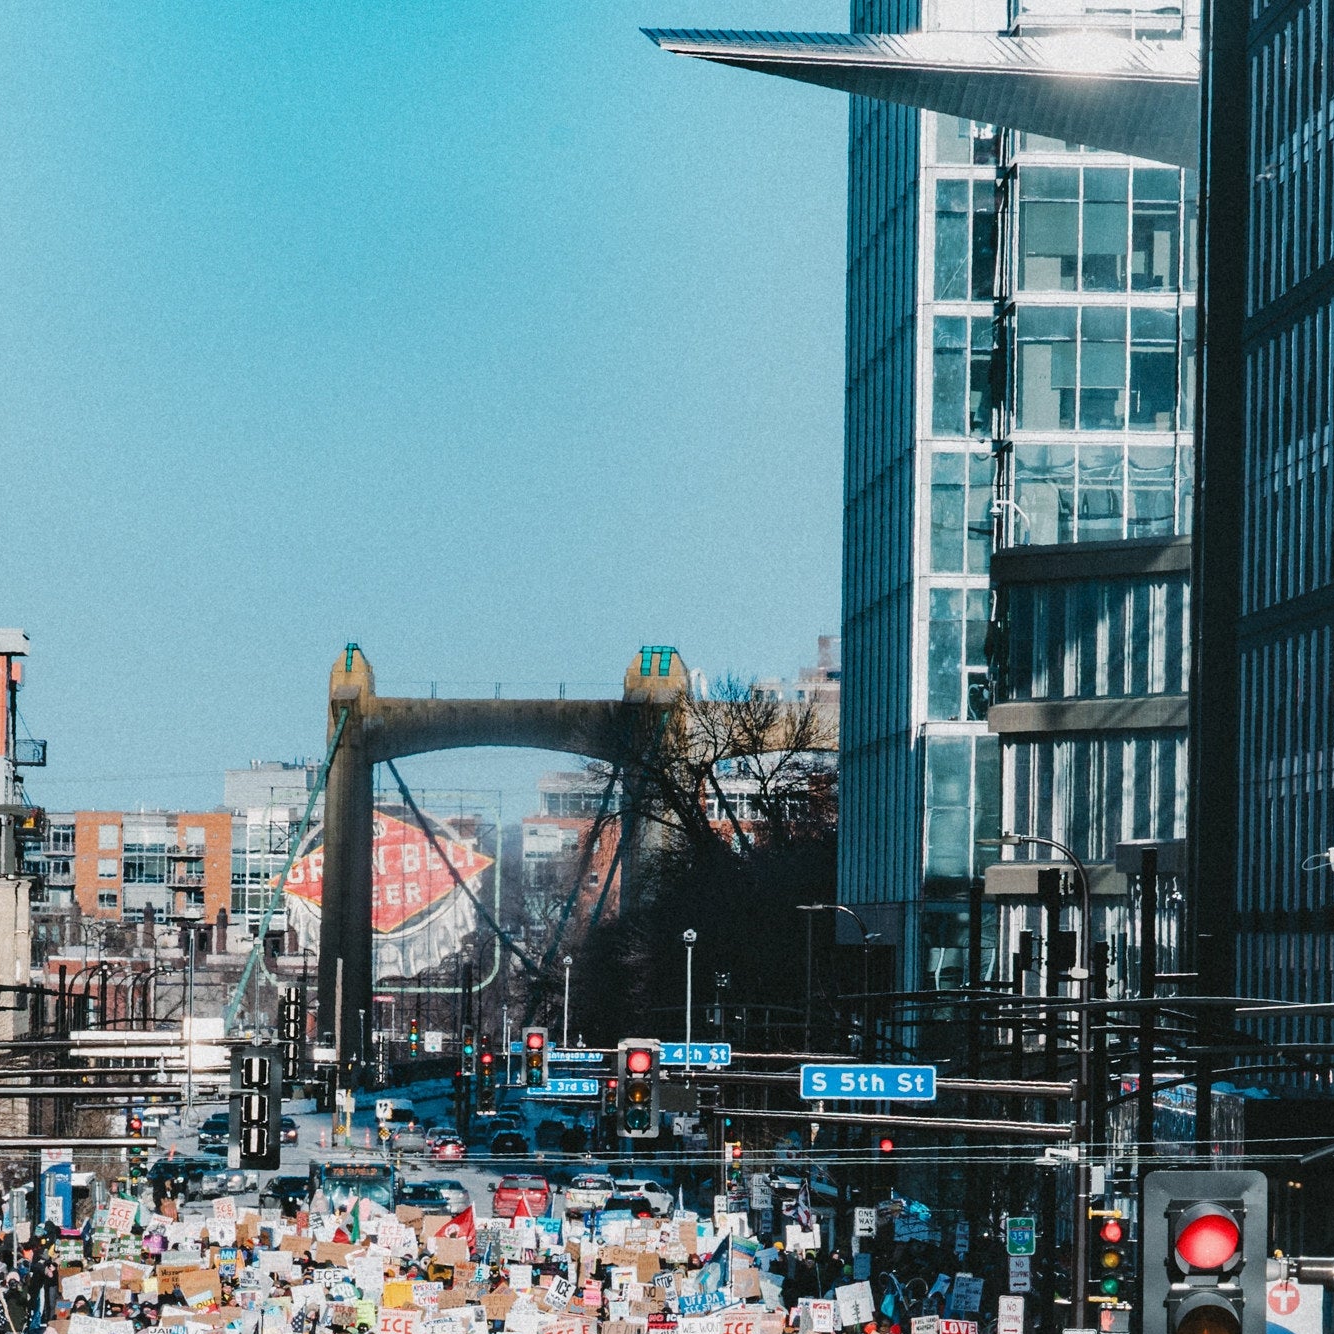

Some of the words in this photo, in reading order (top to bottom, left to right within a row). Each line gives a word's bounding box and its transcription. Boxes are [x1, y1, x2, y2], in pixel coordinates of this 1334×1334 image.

[404, 841, 476, 875] BELT
[372, 885, 421, 906] EER
[671, 1049, 702, 1065] 4th
[710, 1049, 727, 1065] St
[558, 1080, 579, 1093] 3rd
[584, 1080, 596, 1093] St
[812, 1073, 827, 1092] S
[840, 1072, 883, 1093] 5th
[897, 1072, 923, 1093] St
[1012, 1232, 1029, 1242] 35W
[1007, 1304, 1017, 1312] NO
